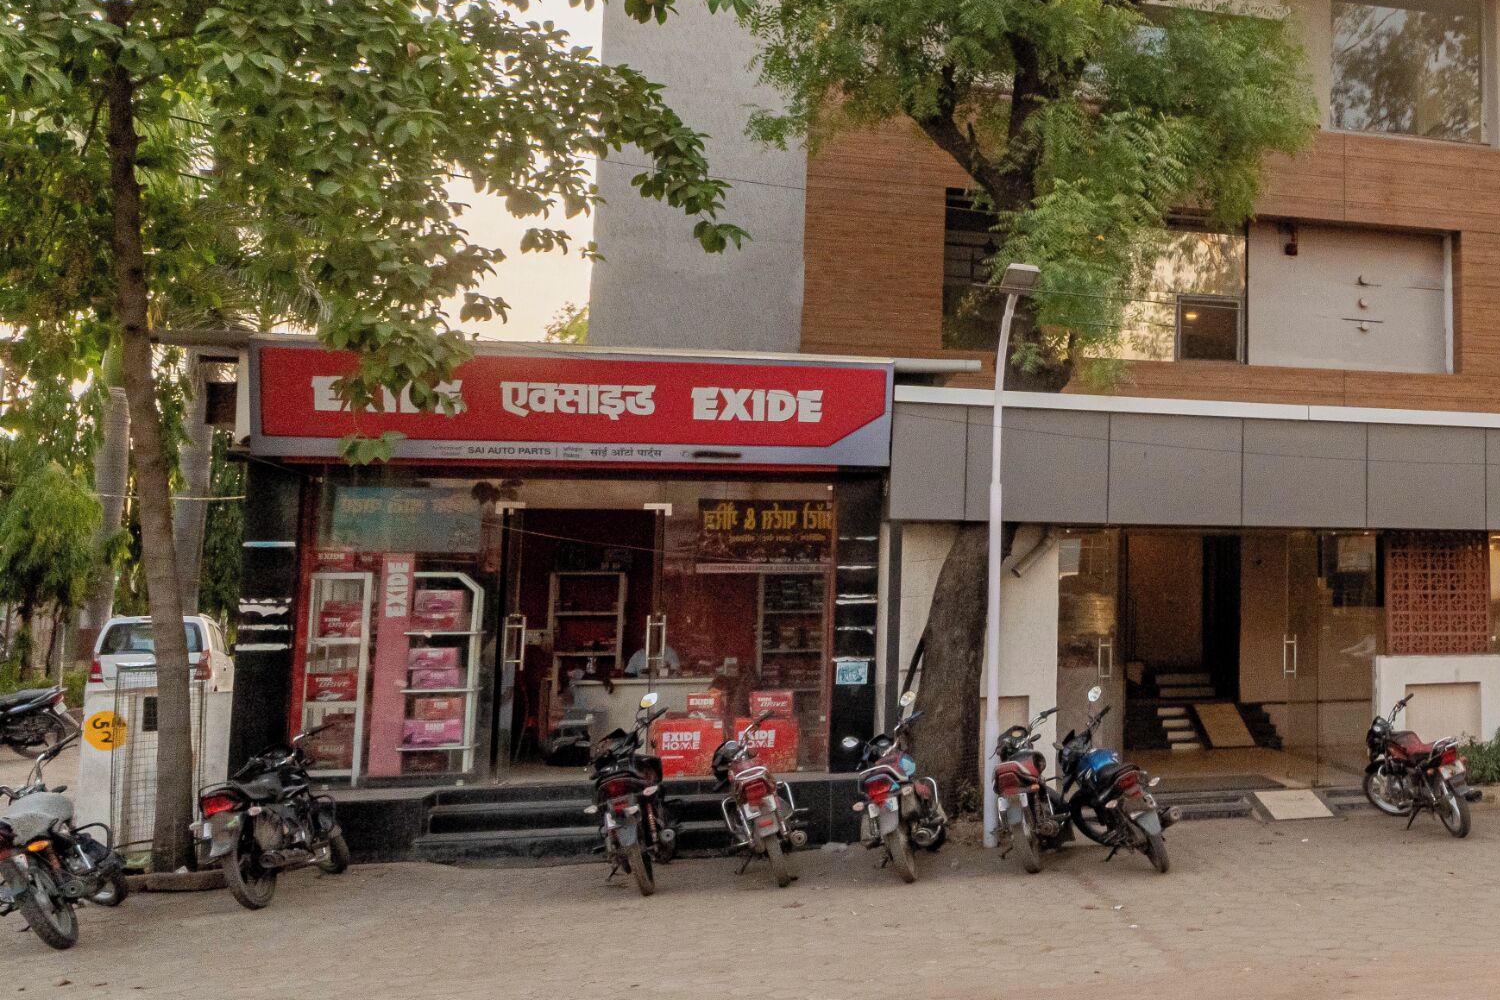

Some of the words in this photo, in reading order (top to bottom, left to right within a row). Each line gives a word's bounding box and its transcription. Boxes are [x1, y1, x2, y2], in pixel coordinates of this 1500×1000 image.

[500, 381, 656, 420] एक्साइड
[691, 387, 823, 422] EXIDE
[468, 446, 484, 454] SAI
[488, 447, 515, 455] AUTO
[518, 447, 551, 455] PARTS
[385, 562, 409, 616] EXIDE
[662, 731, 701, 742] EXIDE
[662, 741, 700, 750] HOME
